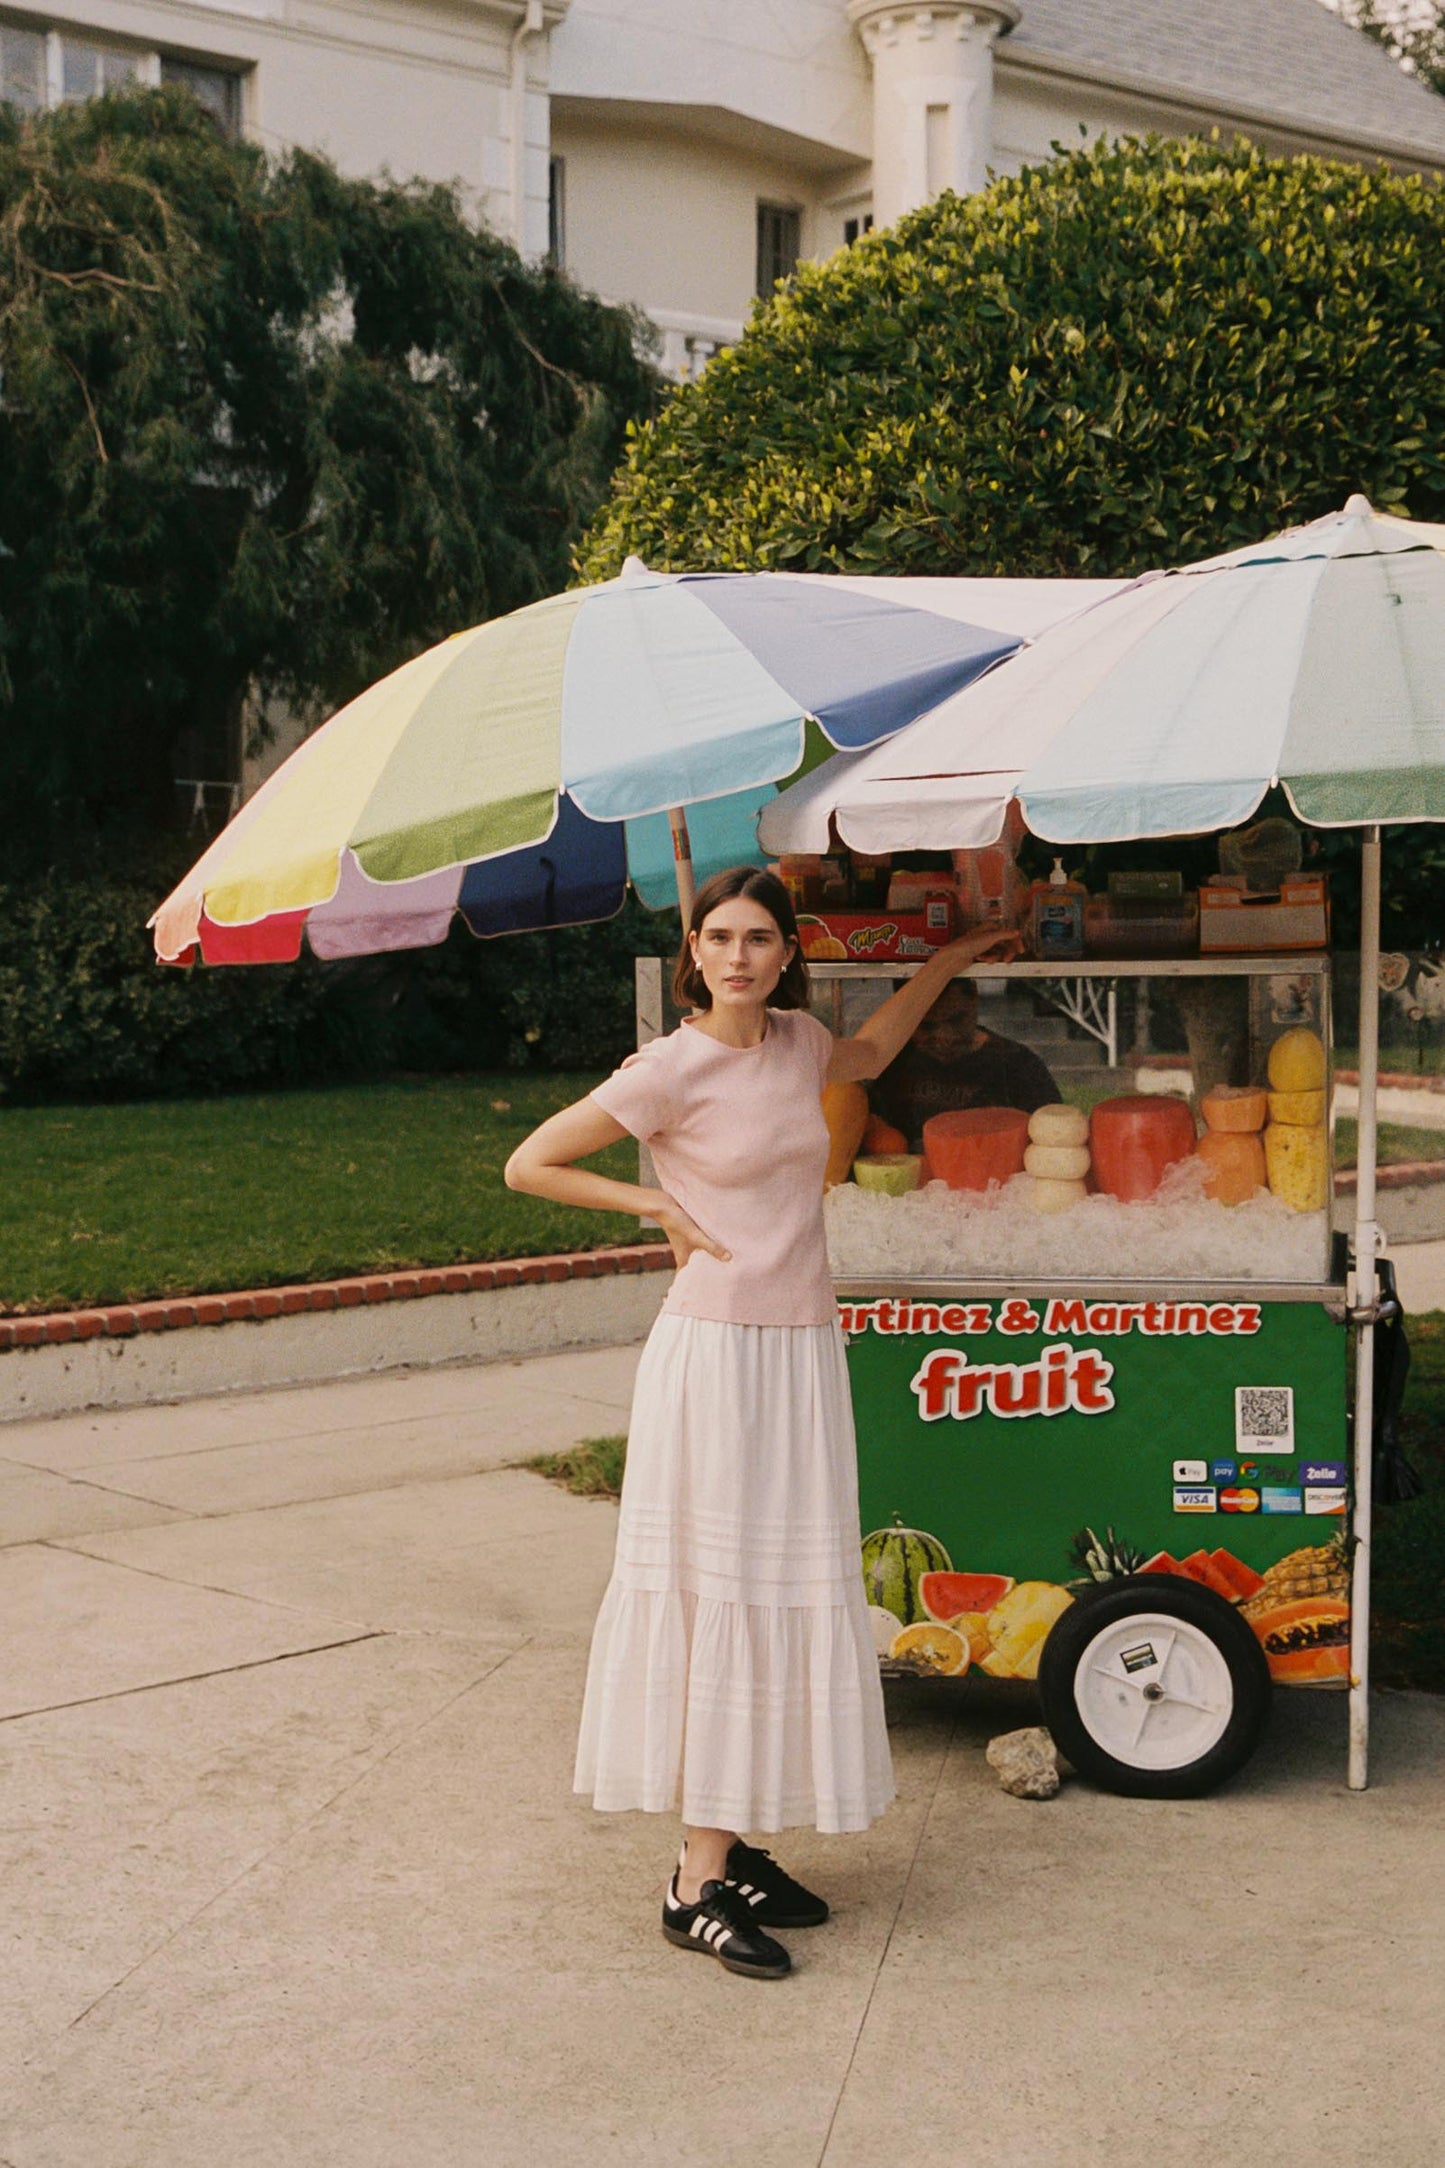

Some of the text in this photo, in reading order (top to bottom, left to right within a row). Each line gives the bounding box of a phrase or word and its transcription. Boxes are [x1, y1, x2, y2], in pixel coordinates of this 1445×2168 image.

[1000, 1299, 1038, 1334] &
[1047, 1298, 1260, 1333] Martinez
[915, 1347, 1109, 1417] fruit
[1214, 1468, 1233, 1477] pay
[1306, 1466, 1337, 1480] Zelle
[1181, 1494, 1209, 1504] VISA
